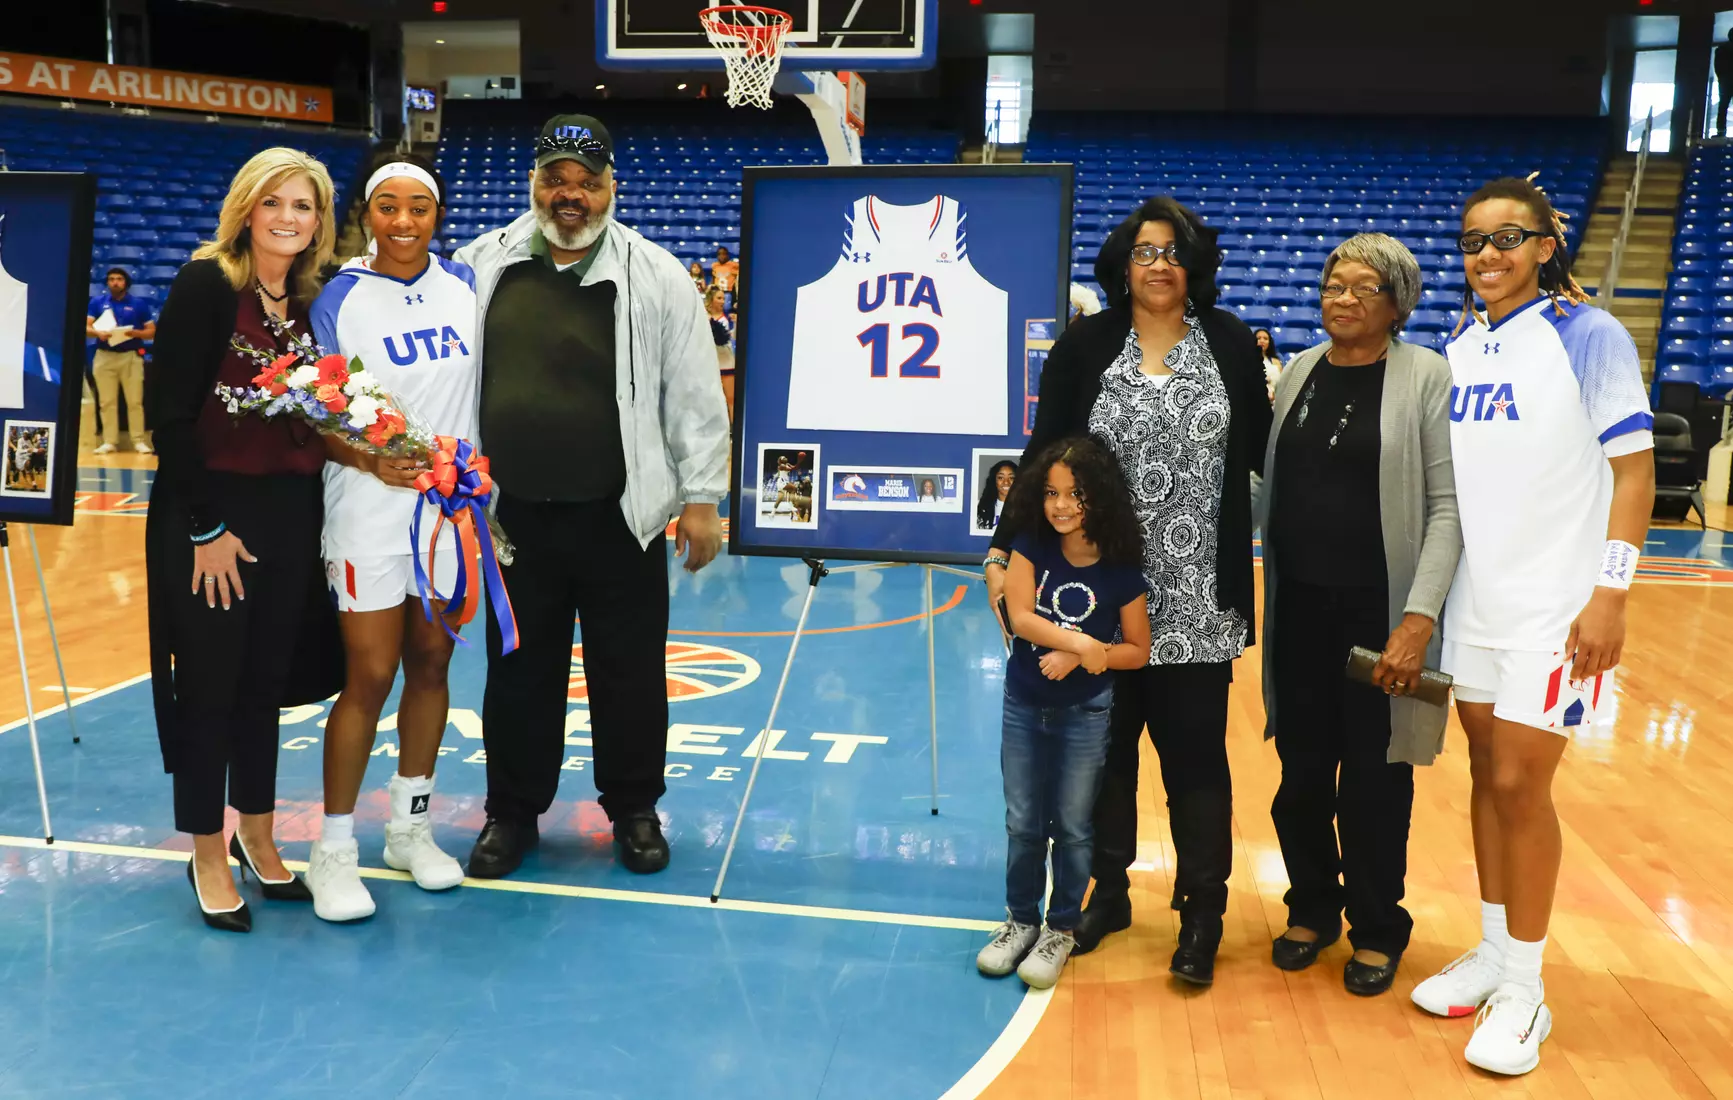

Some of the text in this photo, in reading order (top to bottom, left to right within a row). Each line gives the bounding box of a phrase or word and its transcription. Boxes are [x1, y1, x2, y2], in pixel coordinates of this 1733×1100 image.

[27, 61, 75, 91] AT
[88, 68, 297, 114] ARLINGTON
[554, 125, 592, 139] UTA
[857, 272, 943, 318] UTA
[382, 325, 470, 366] UTA
[856, 322, 940, 378] 12
[1450, 383, 1520, 422] UTA
[878, 486, 909, 498] BENSON
[943, 476, 954, 490] 12
